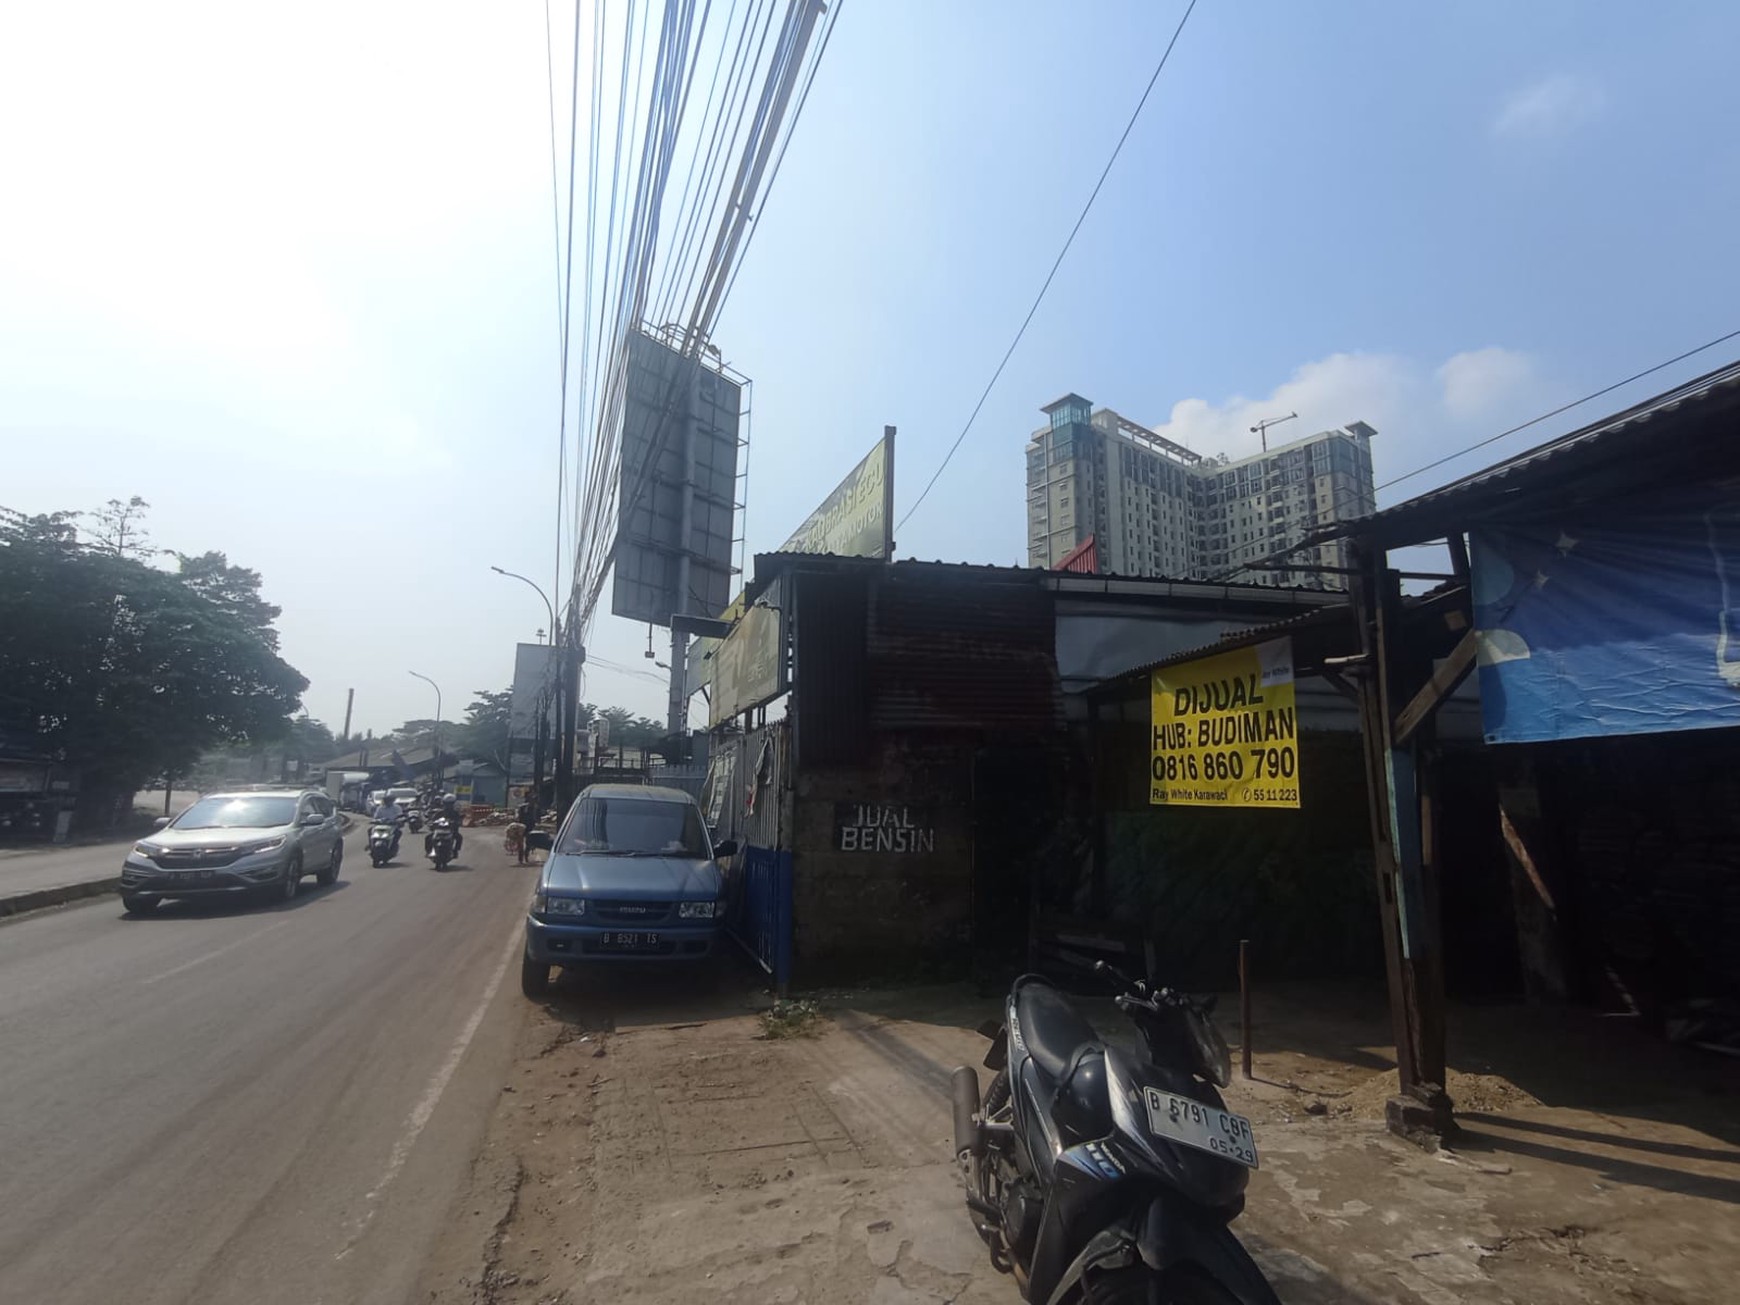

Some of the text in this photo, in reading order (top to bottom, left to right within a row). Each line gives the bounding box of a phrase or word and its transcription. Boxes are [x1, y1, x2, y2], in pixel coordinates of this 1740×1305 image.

[1174, 673, 1264, 717] DIJUAL
[1153, 707, 1294, 751] HUB: BUDIMAN
[1153, 747, 1295, 781] 0816 860 790
[853, 804, 915, 828] JUAL
[841, 826, 934, 853] BENSIN
[1149, 1091, 1249, 1140] B 6791 CBF
